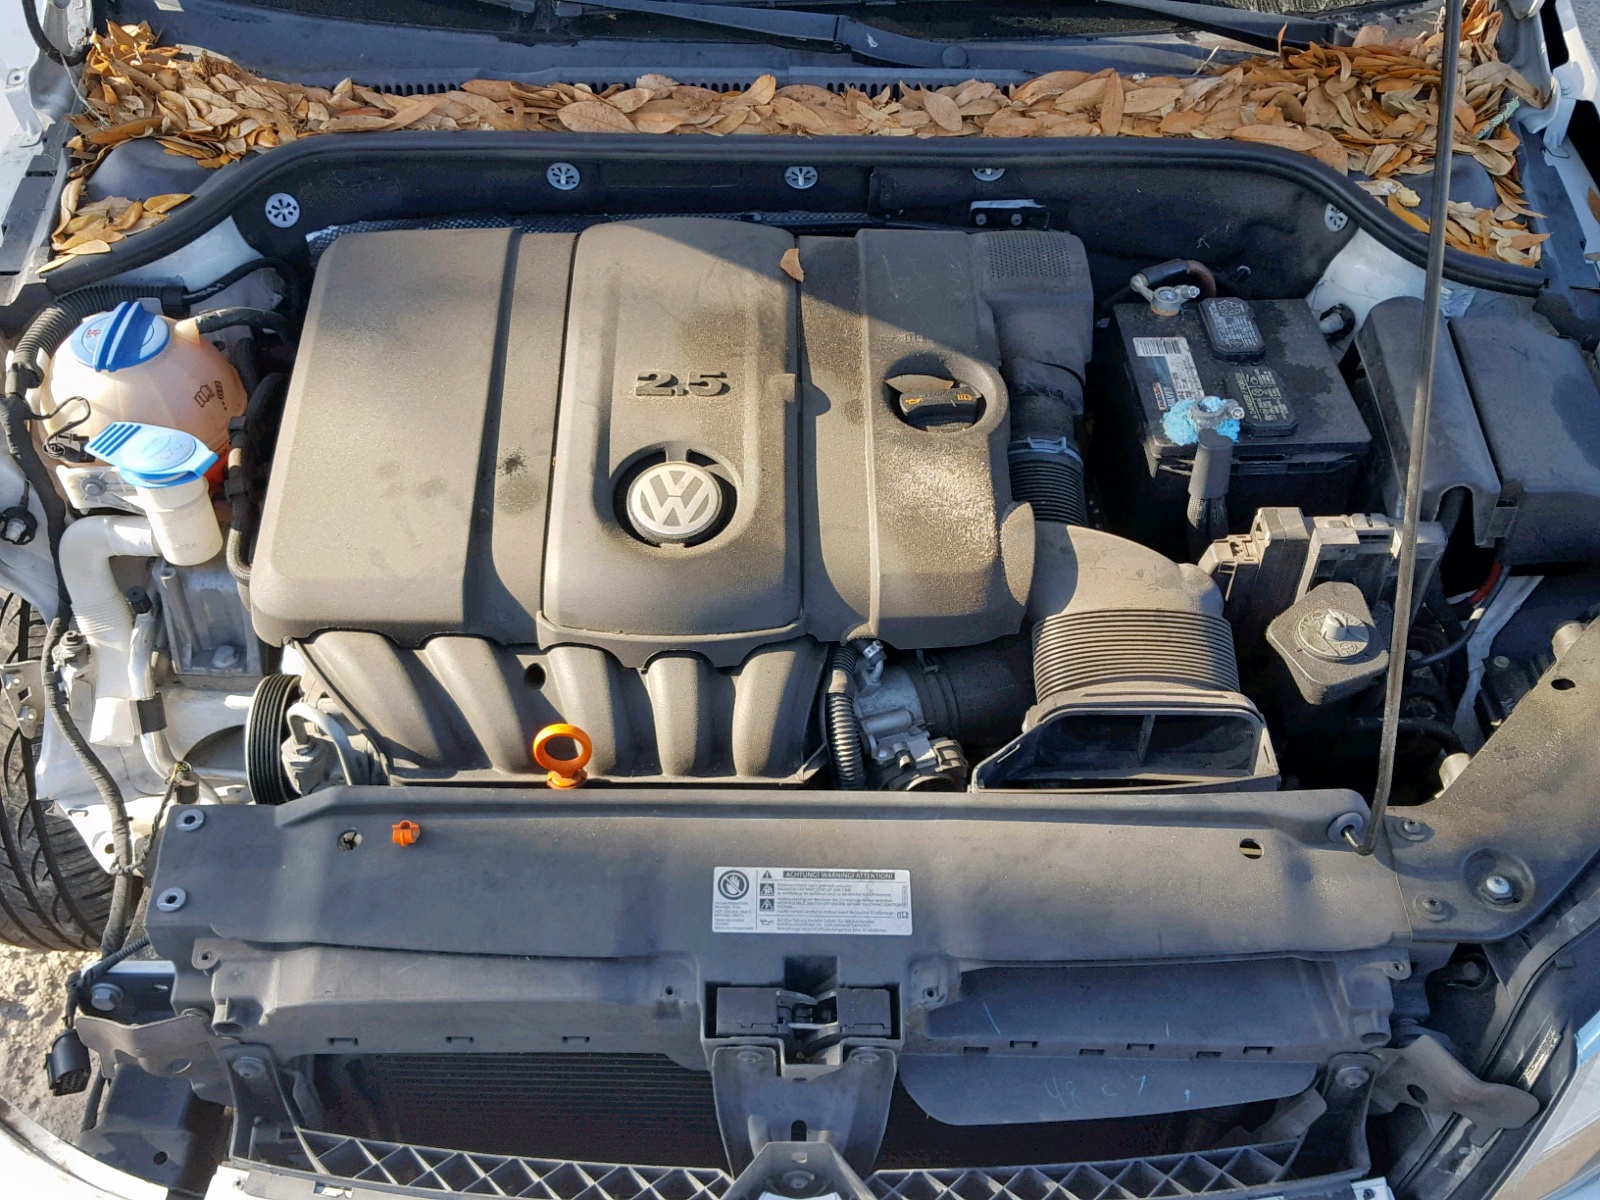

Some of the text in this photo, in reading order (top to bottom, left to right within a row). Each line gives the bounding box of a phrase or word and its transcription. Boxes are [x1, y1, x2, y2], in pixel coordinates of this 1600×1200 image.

[635, 370, 731, 397] 2.5
[785, 871, 893, 880] ACHTUNG! WARNING! ATTENTION!
